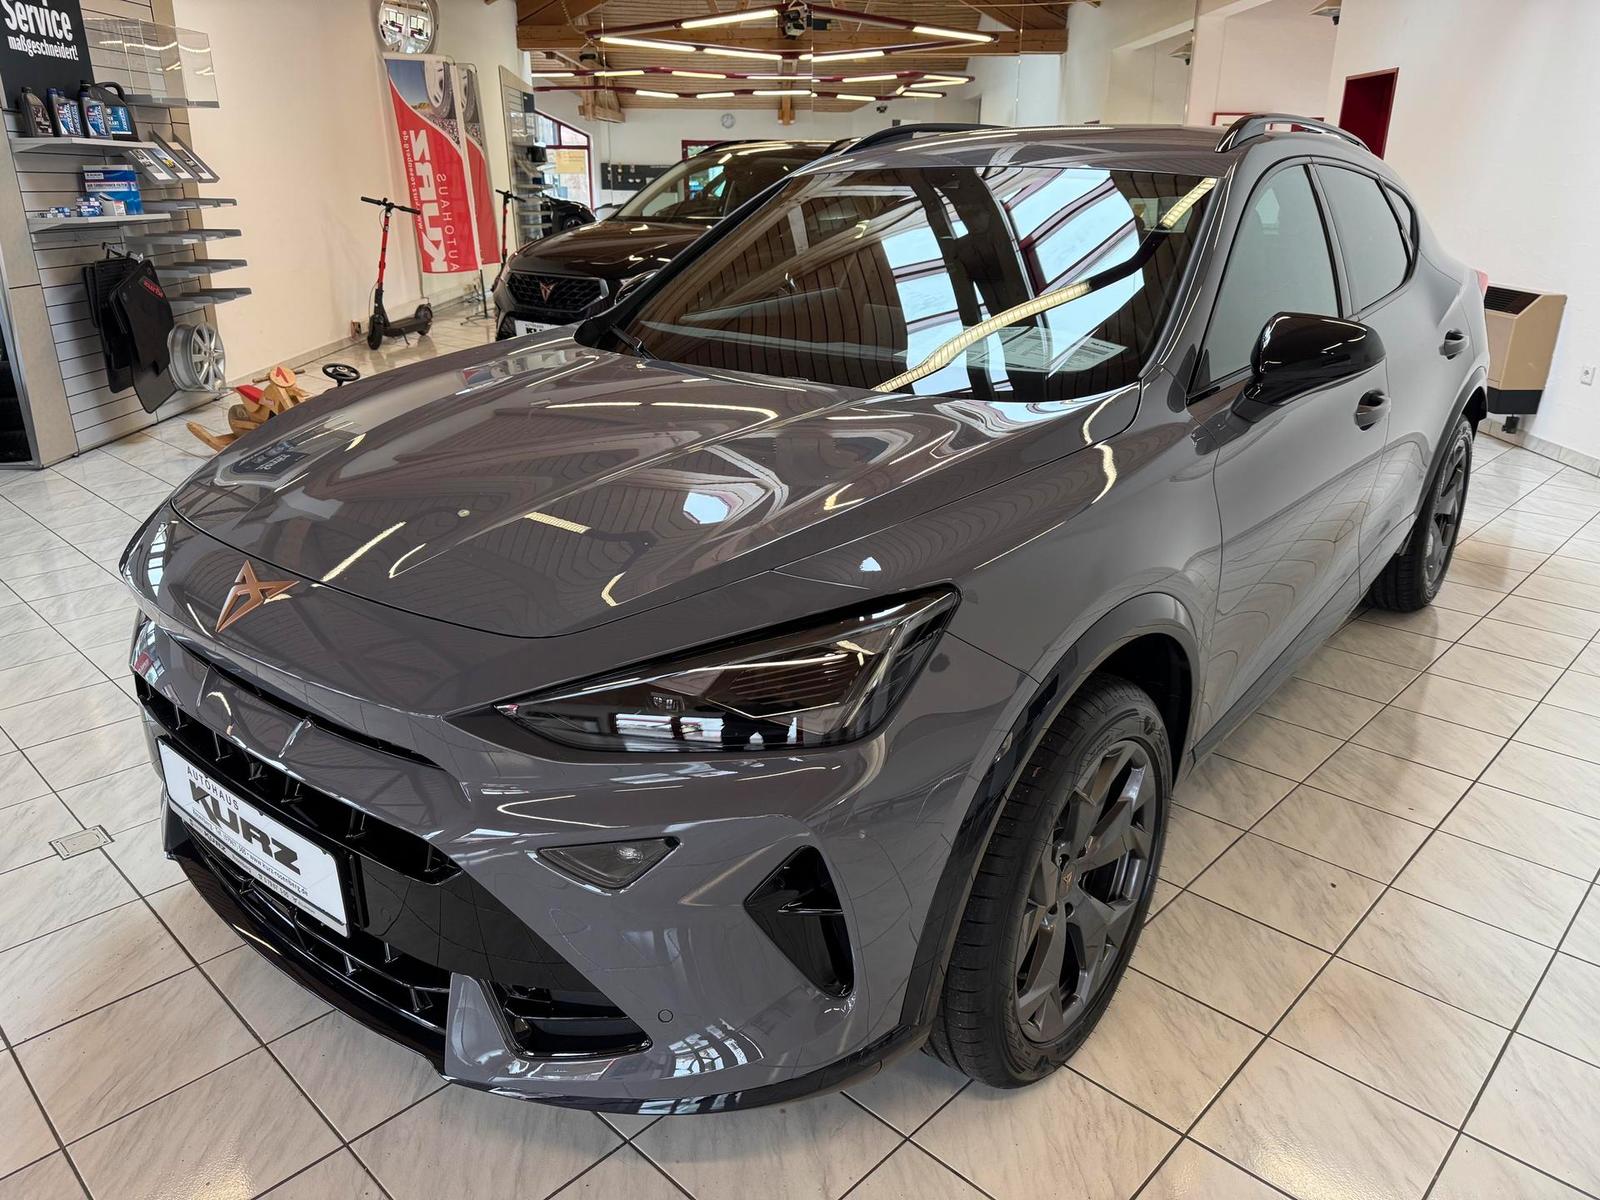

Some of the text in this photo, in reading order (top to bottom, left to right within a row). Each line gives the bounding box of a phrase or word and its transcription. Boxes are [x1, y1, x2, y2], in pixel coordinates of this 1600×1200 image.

[0, 0, 73, 41] Service
[7, 34, 79, 61] maßgeschneidert!
[187, 766, 239, 810] AUTOHAUS
[189, 779, 301, 876] KURZ
